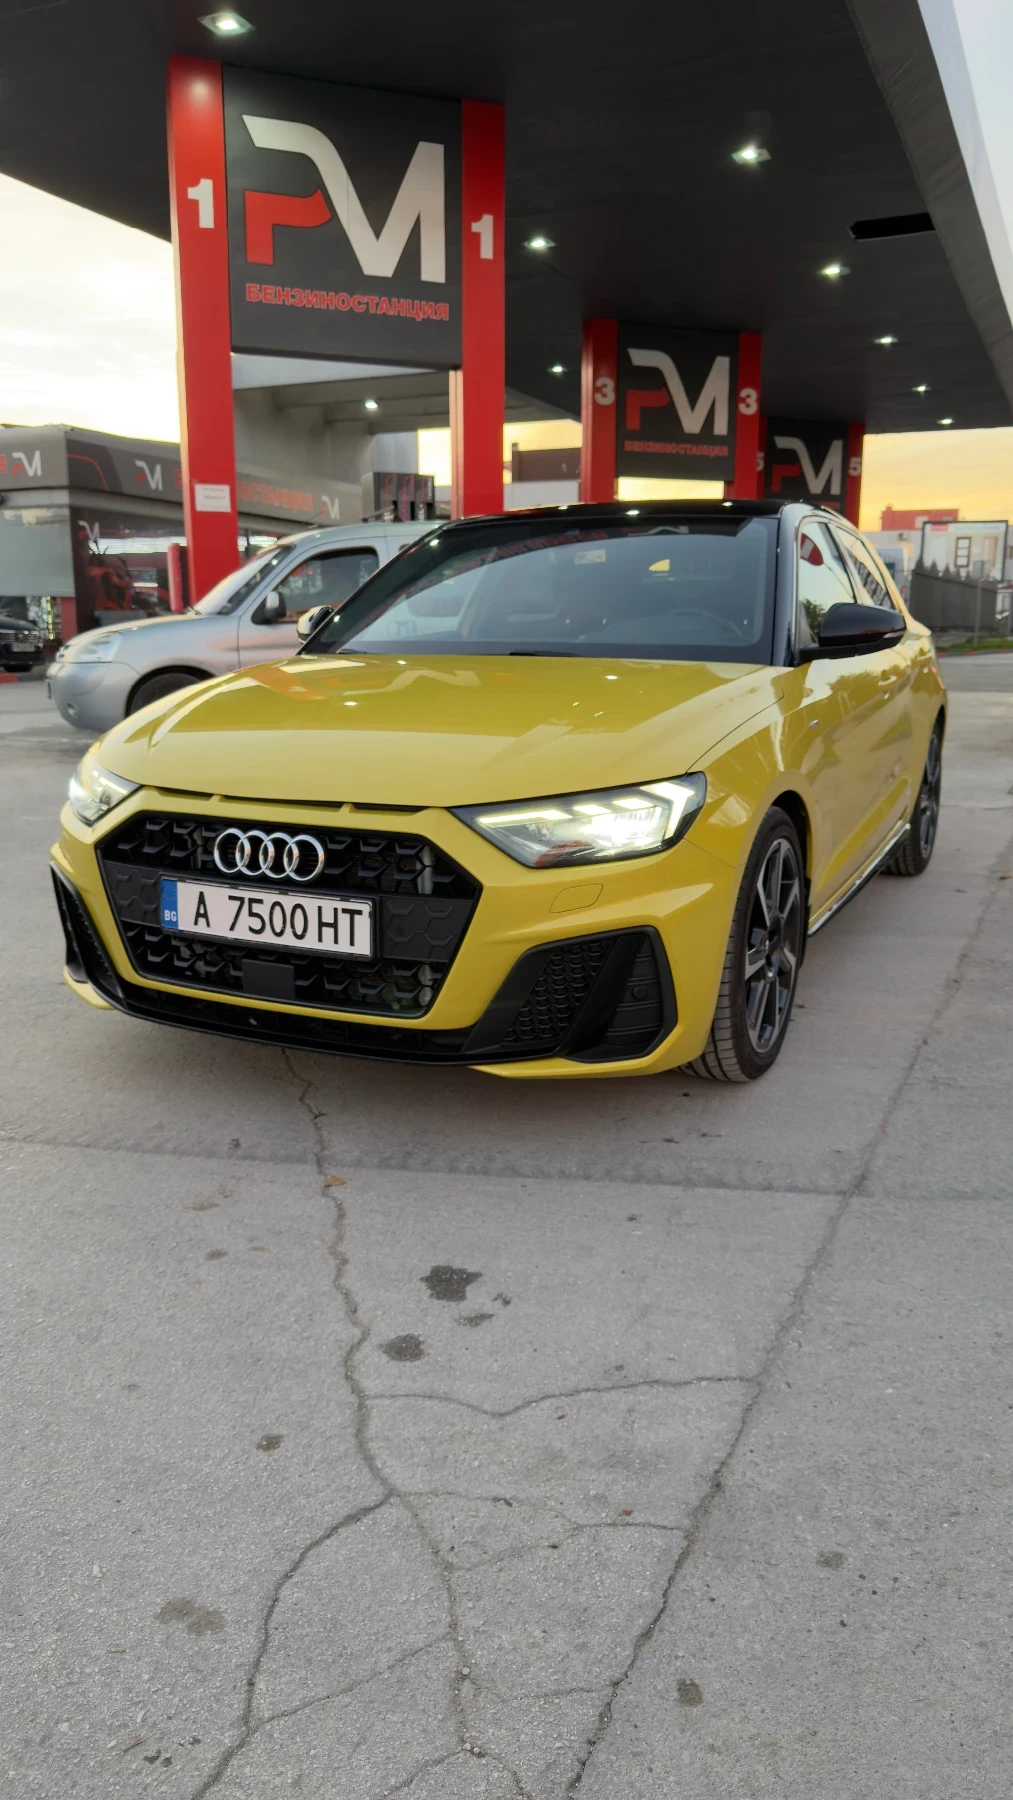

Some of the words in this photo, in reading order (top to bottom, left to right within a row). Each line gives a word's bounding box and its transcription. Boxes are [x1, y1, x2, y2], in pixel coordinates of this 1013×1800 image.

[187, 178, 215, 229] 1
[471, 214, 494, 260] 1
[246, 283, 449, 322] БЕНЗИНОСТАНЦИЯ
[594, 377, 615, 406] 3
[738, 388, 758, 415] 3
[848, 457, 862, 476] 5
[164, 909, 178, 922] BG
[193, 891, 211, 928] A
[228, 895, 309, 940] 7500
[318, 906, 363, 947] HT
